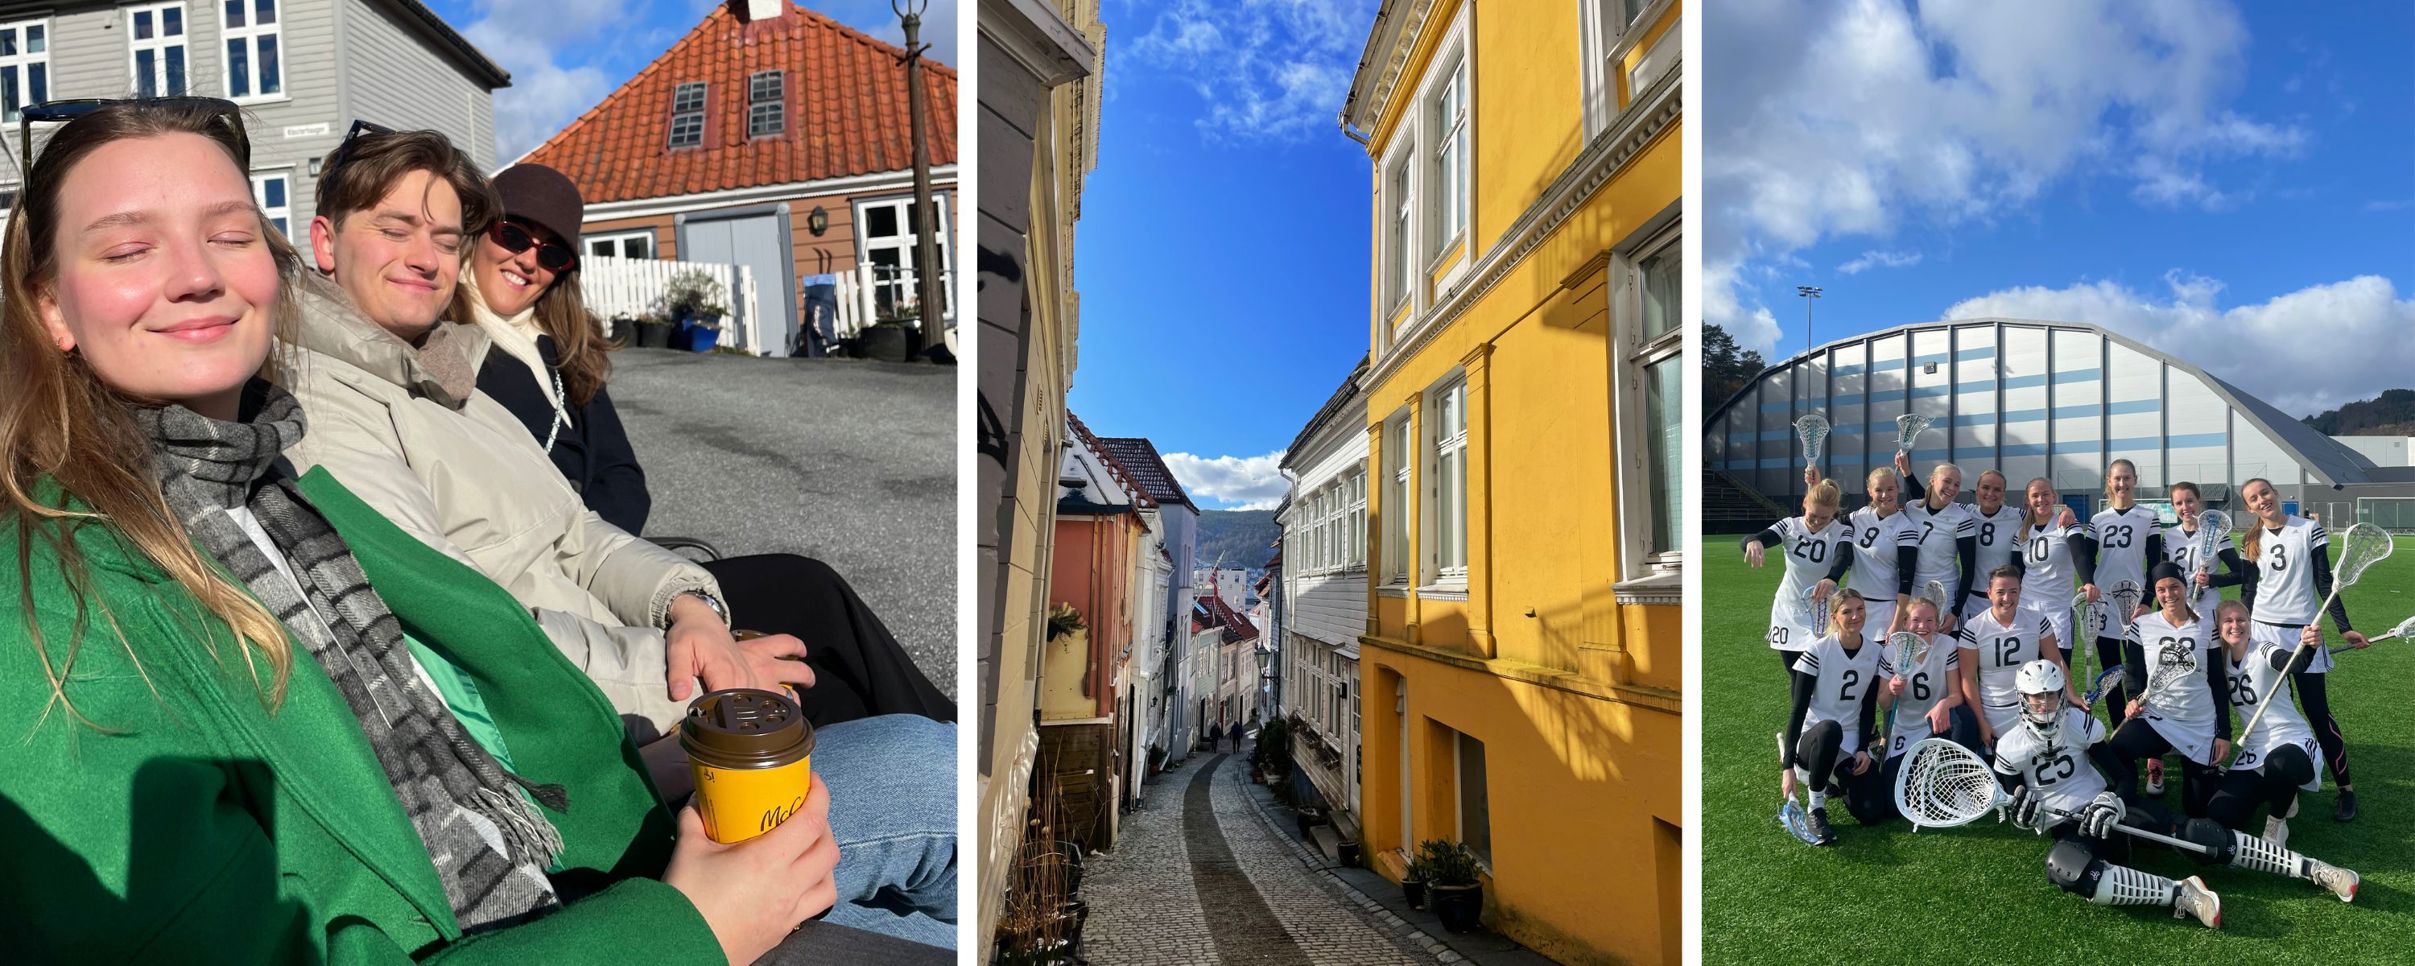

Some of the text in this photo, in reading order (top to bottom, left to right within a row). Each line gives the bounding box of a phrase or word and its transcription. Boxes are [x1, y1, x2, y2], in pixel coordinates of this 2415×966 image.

[1860, 526, 1880, 548] 9
[1918, 520, 1934, 545] 7
[1980, 522, 1995, 547] 8
[2103, 525, 2133, 548] 23
[1794, 534, 1826, 563] 20
[2028, 536, 2049, 563] 10
[2175, 546, 2196, 572] 21
[2270, 543, 2287, 571] 3
[1772, 626, 1789, 644] 20
[1995, 636, 2021, 667] 12
[1840, 669, 1859, 701] 2
[1912, 672, 1931, 701] 6
[2228, 673, 2258, 707] 26
[1894, 735, 1906, 750] 6
[2032, 748, 2075, 786] 25
